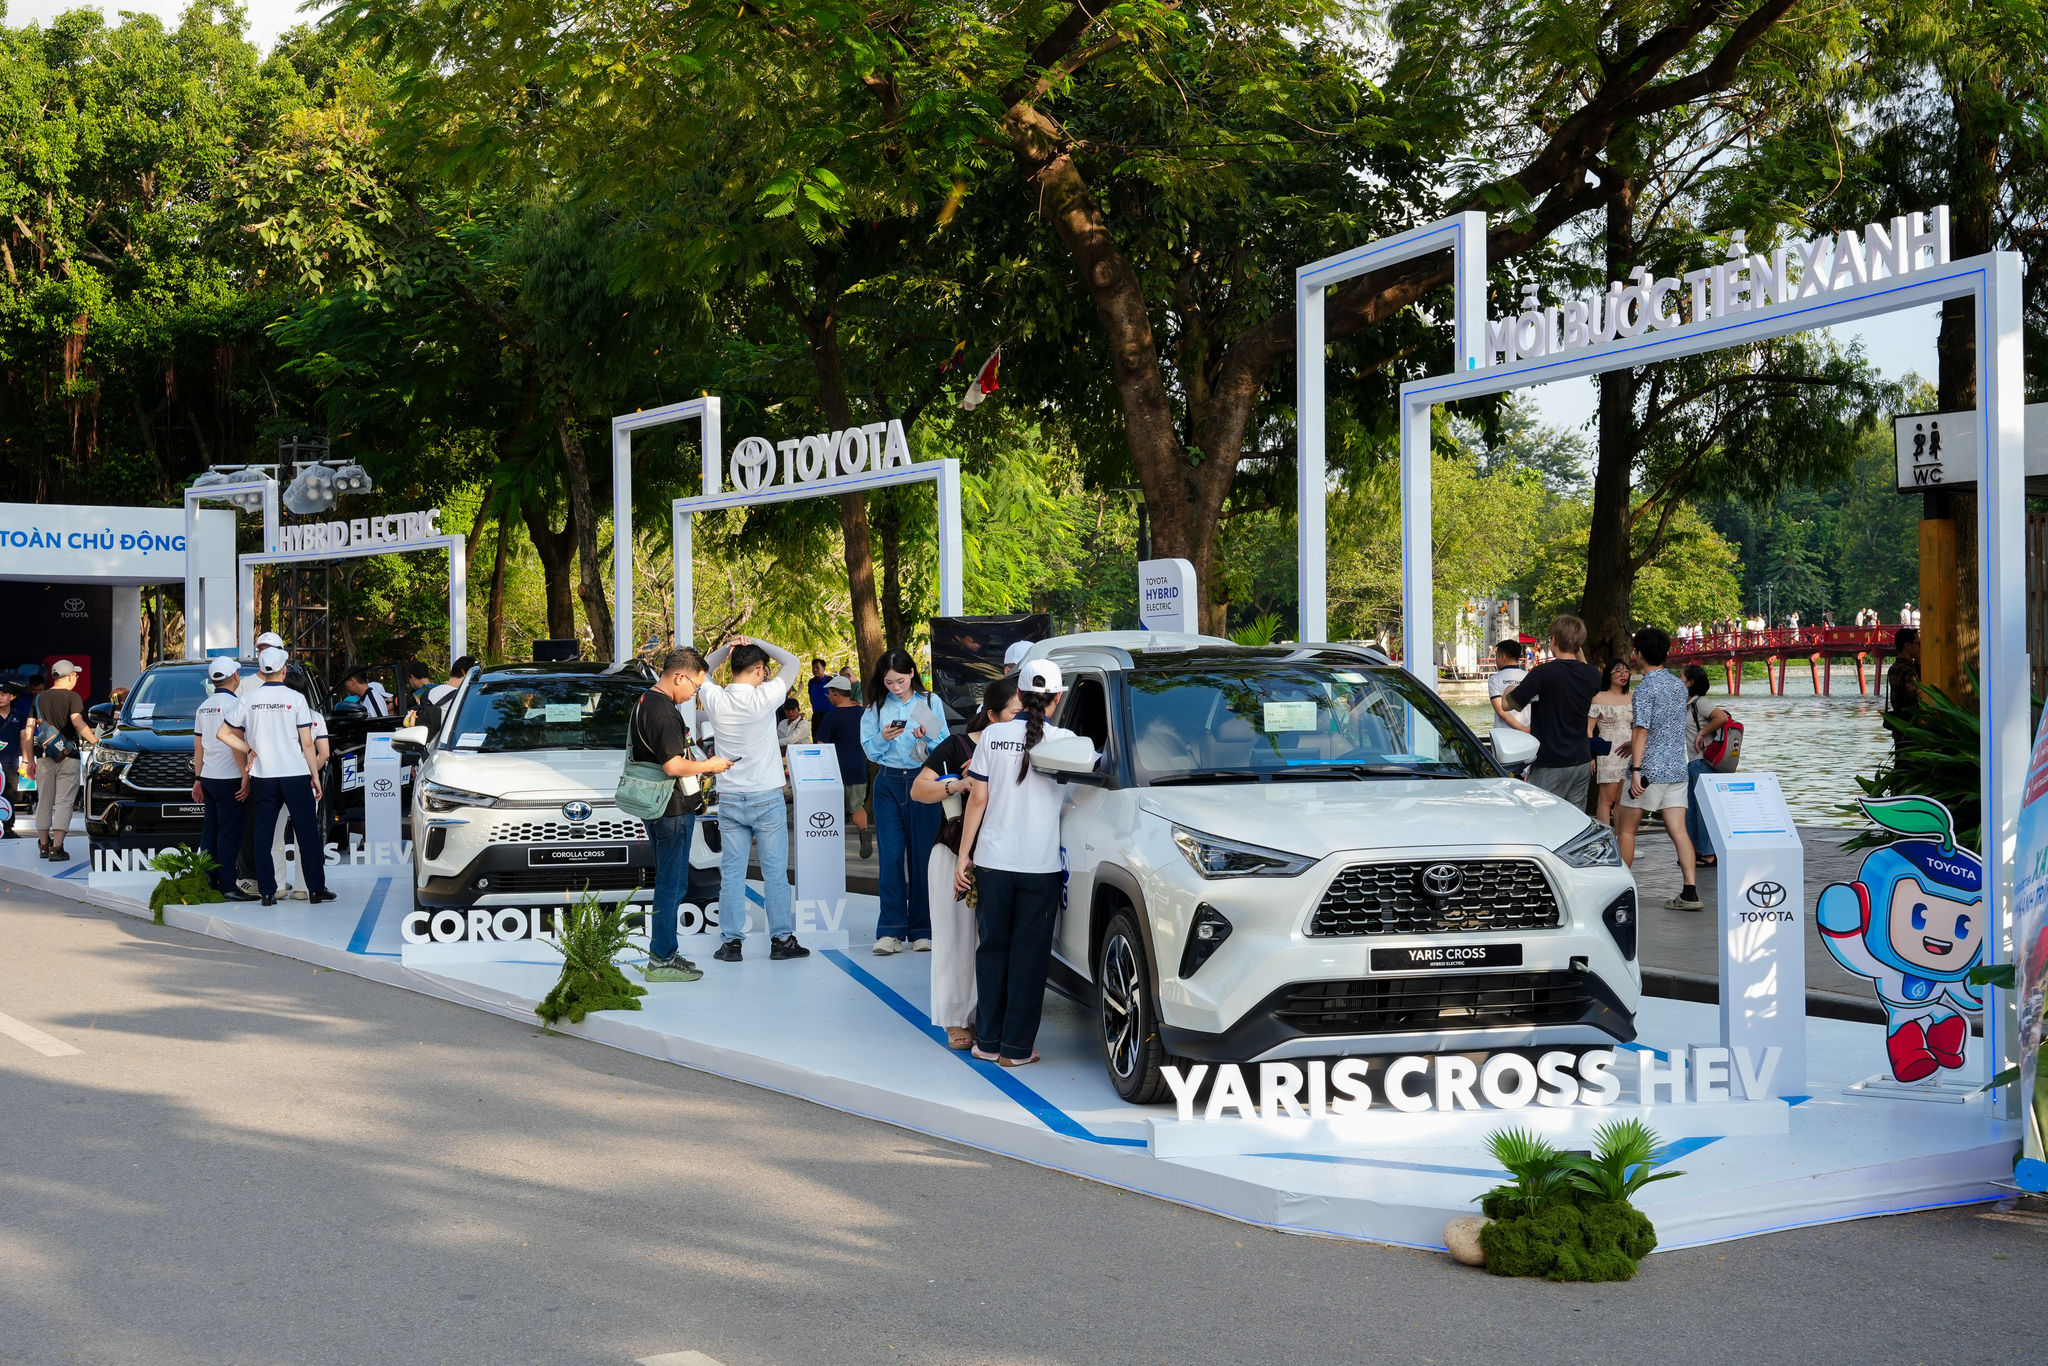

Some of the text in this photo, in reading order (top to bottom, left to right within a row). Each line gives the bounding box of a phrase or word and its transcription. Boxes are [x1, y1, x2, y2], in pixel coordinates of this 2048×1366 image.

[1485, 204, 1950, 367] MỖI BƯỚC TIẾN XANH
[777, 418, 912, 485] TOYOTA
[1913, 468, 1944, 485] WC
[0, 527, 186, 556] TOÀN CHỦ ĐỘNG
[280, 508, 441, 552] HYBRID ELECTRIC
[1145, 586, 1179, 600] HYBRID
[1146, 576, 1168, 586] TOYOTA
[1146, 602, 1172, 612] ELECTRIC
[348, 840, 414, 866] HEV
[1925, 857, 1977, 881] TOYOTA
[1739, 911, 1794, 923] TOYOTA
[1408, 947, 1486, 961] YARIS CROSS
[1159, 1046, 1783, 1122] YARIS CROSS HEV
